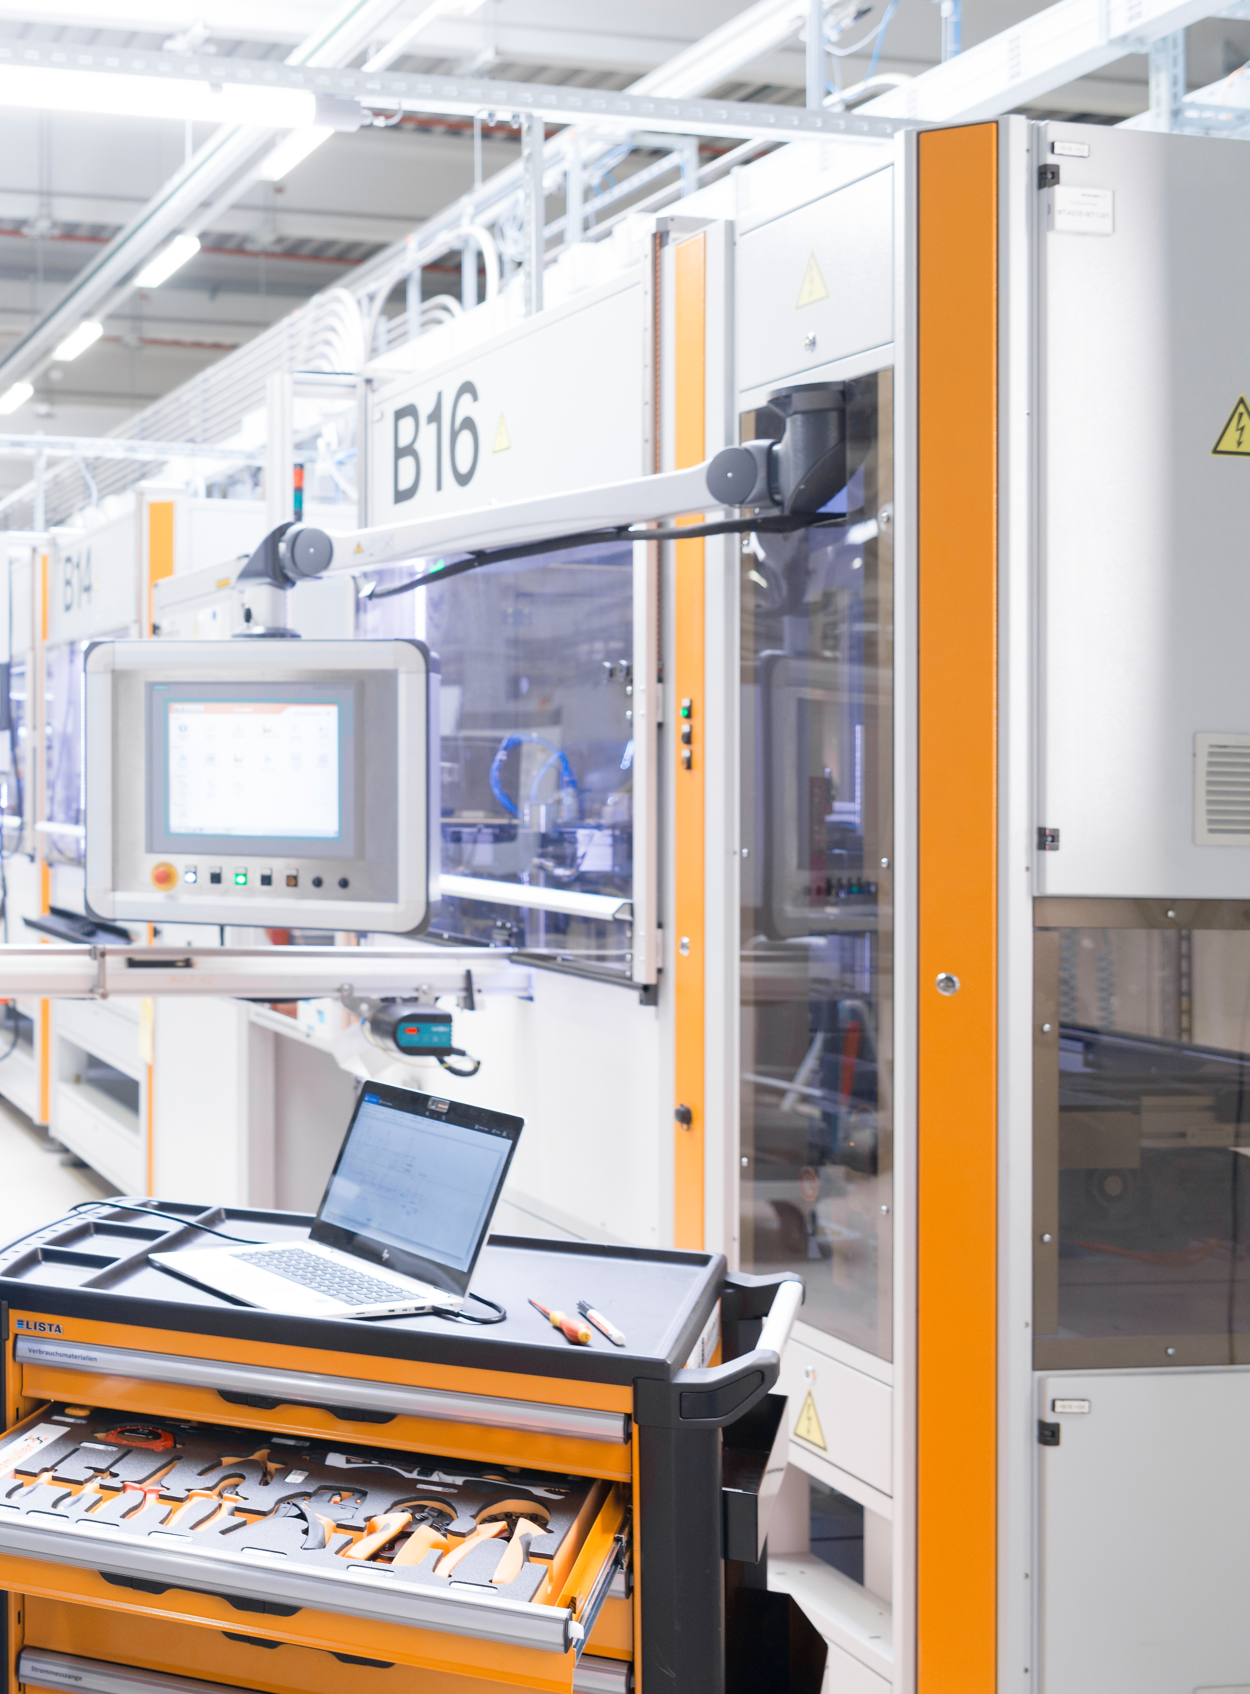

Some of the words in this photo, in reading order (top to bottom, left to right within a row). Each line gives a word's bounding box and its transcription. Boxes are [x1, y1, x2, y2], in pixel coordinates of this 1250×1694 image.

[393, 380, 479, 505] B16
[26, 1320, 62, 1333] LISTA
[27, 1347, 97, 1362] Verbrauchsmaterialien
[31, 1666, 82, 1681] Strommesszange
